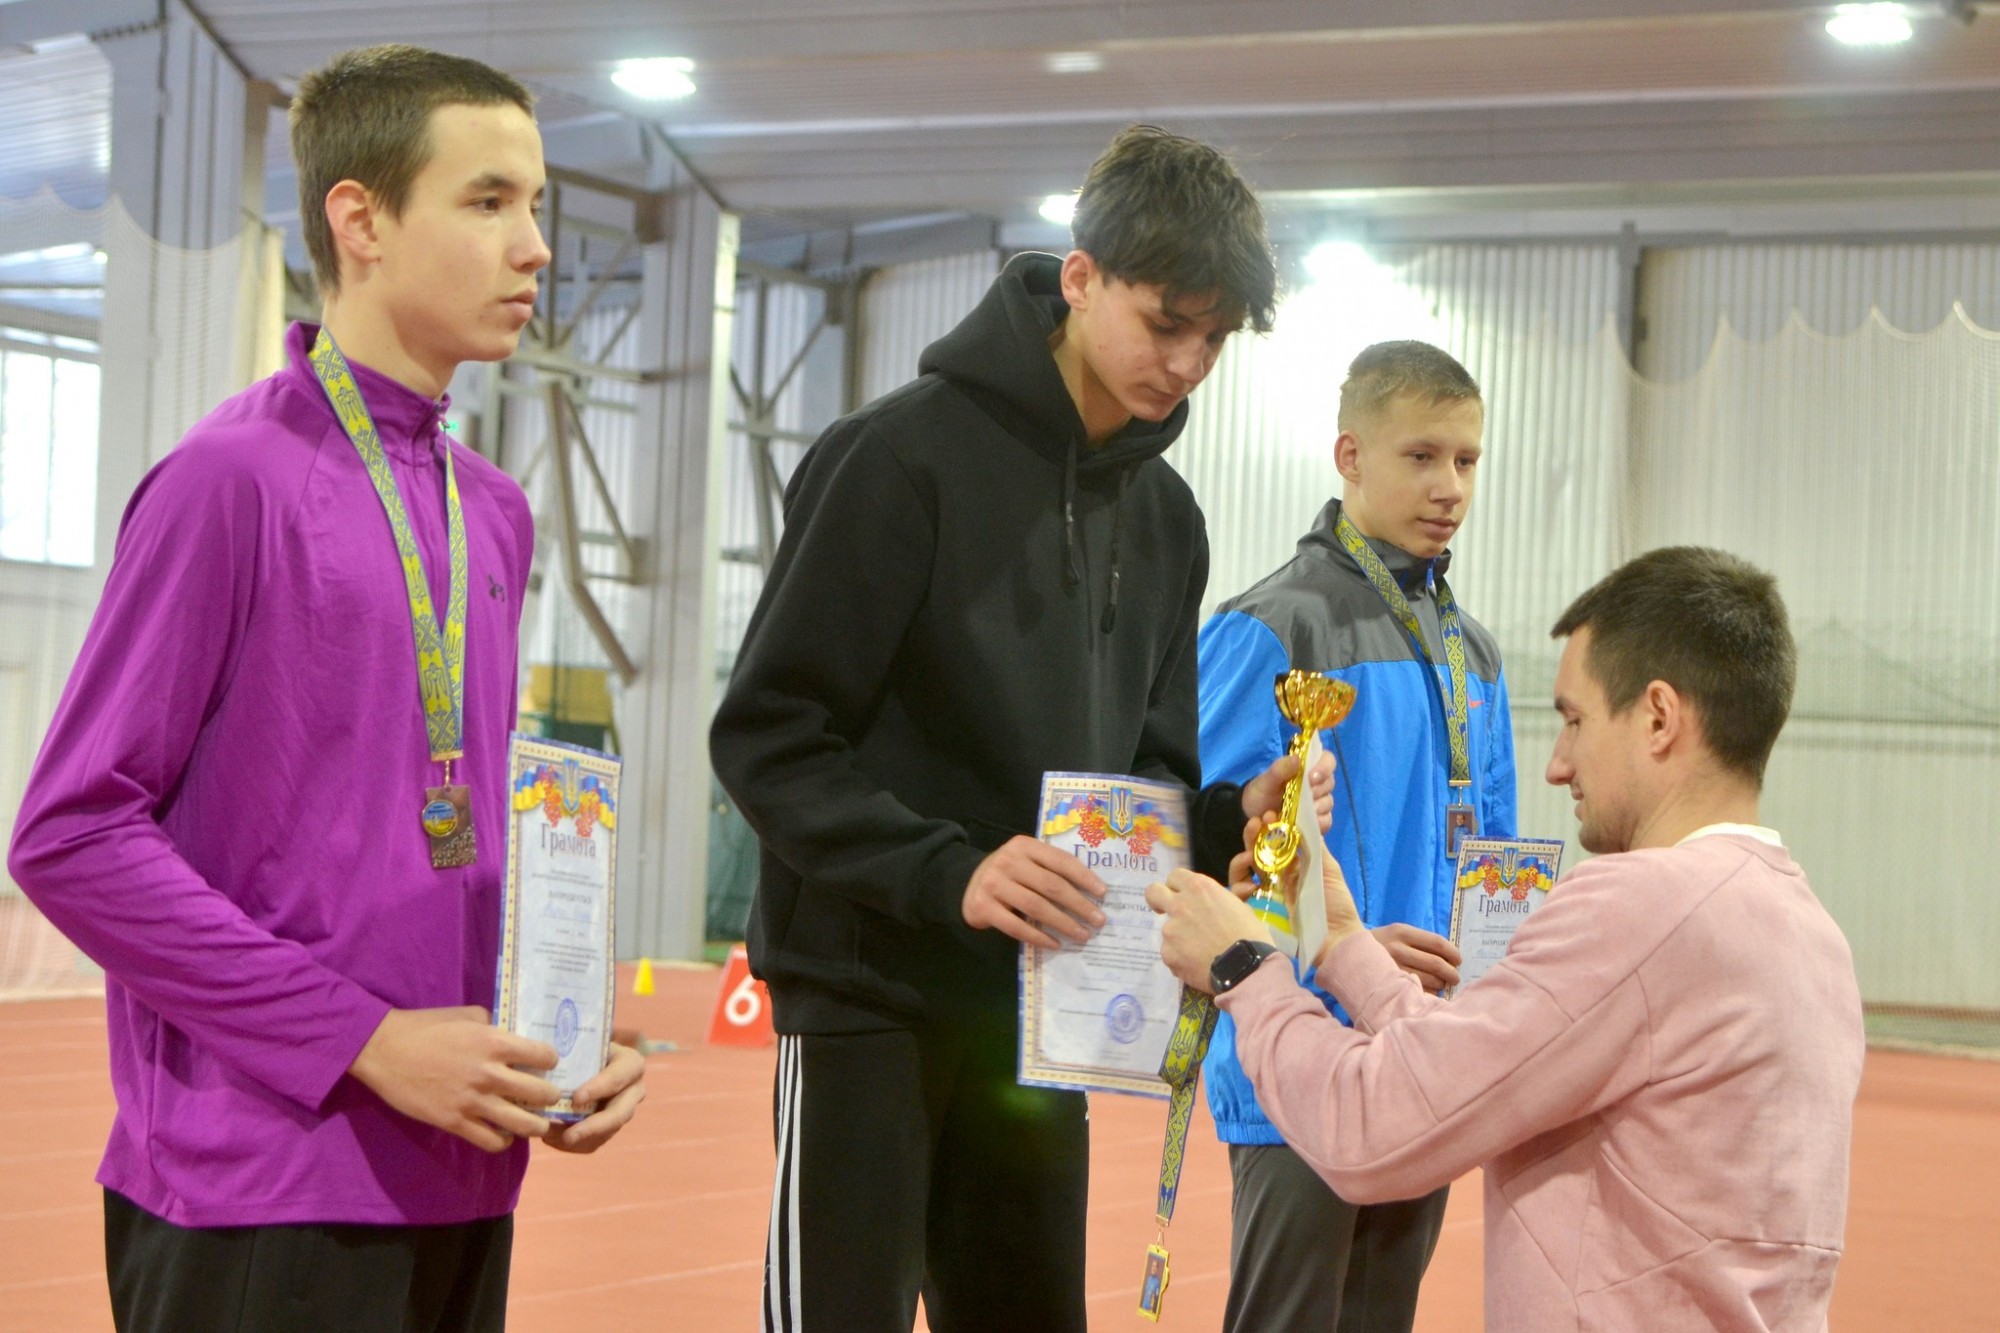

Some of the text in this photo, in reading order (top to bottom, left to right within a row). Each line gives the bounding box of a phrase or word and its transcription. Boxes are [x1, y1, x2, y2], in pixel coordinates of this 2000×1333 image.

[541, 822, 596, 857] Грамота
[1073, 843, 1158, 872] Грамота
[1478, 894, 1530, 917] Грамота
[725, 974, 761, 1027] 6
